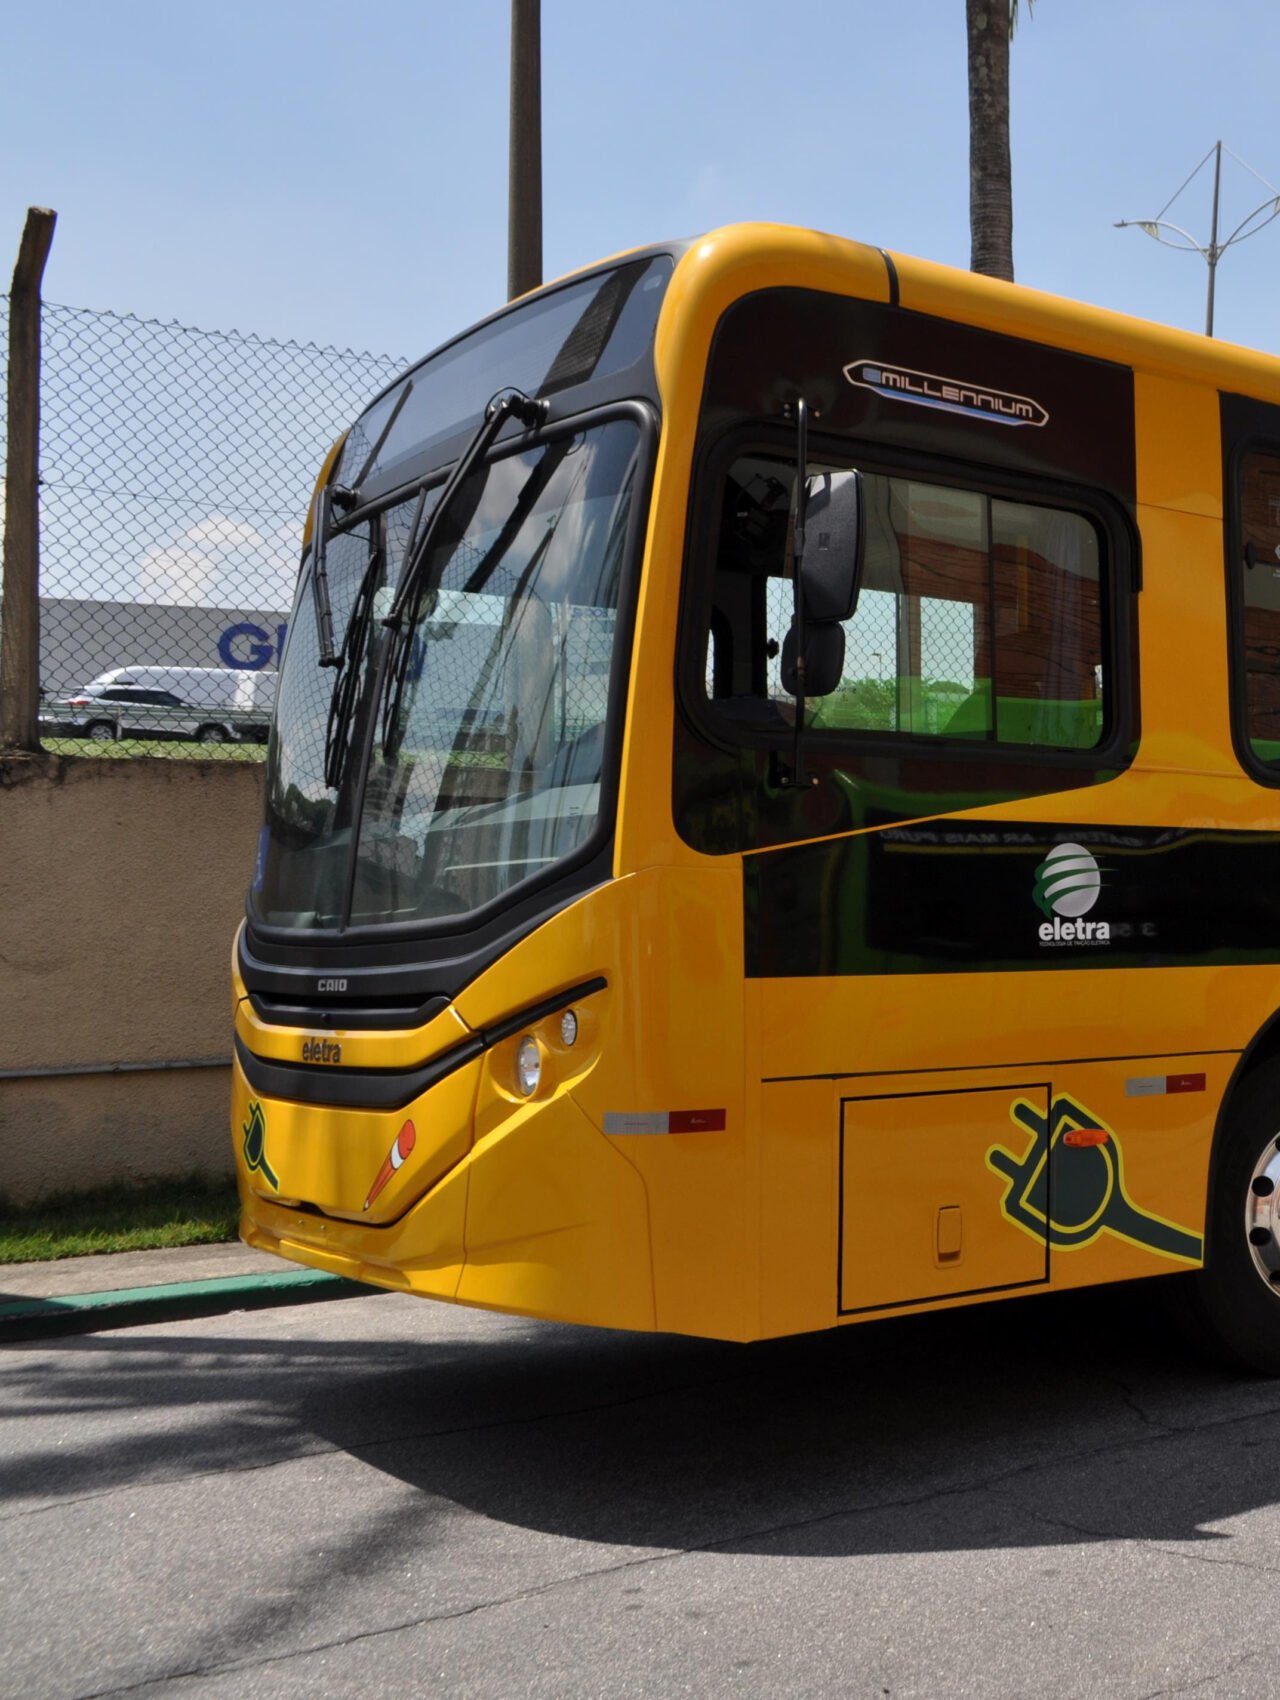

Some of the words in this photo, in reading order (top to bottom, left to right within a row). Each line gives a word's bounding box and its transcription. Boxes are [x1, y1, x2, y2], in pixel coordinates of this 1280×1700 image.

[217, 622, 288, 671] G
[1038, 916, 1110, 941] eletra
[317, 979, 348, 992] CAIO
[302, 1037, 343, 1064] eletra
